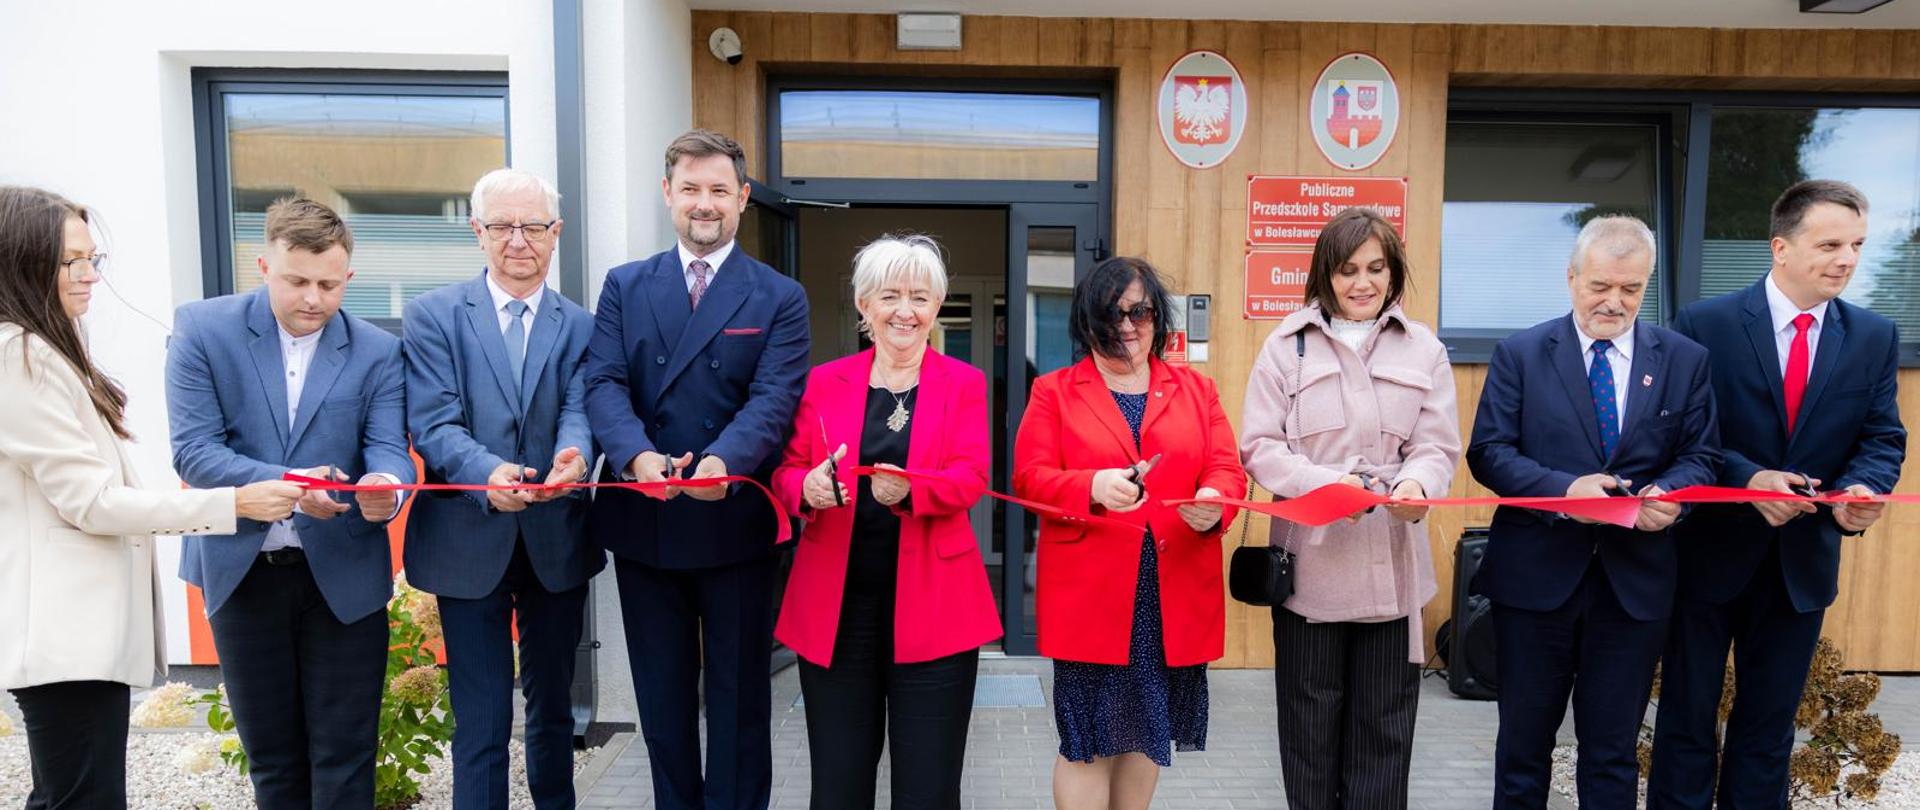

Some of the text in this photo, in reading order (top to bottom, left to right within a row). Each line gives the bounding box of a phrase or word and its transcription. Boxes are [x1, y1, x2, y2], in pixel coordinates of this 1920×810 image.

[1300, 183, 1354, 197] Publiczne
[1253, 203, 1318, 217] Przedszkole
[1254, 229, 1262, 237] w
[1271, 267, 1308, 285] Gmin
[1251, 302, 1261, 311] w
